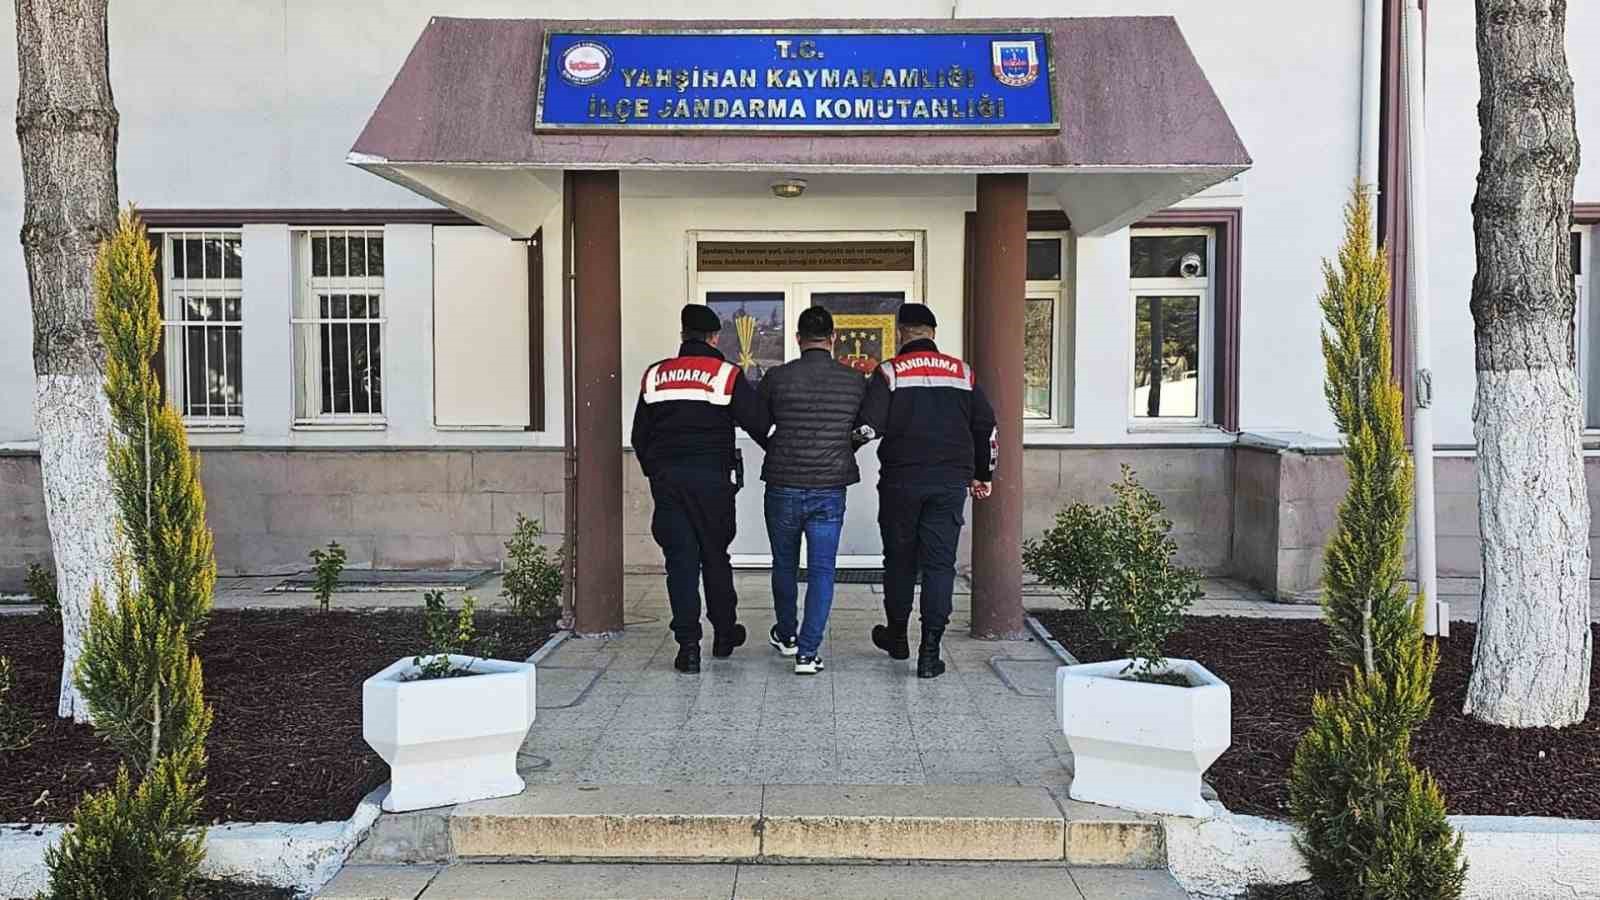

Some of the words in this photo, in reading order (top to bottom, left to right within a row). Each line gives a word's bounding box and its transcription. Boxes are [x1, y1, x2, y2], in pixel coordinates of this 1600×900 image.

[775, 40, 825, 59] T.C.
[621, 65, 757, 93] YAHŞİHAN
[766, 64, 976, 89] KAYMAKAMLIĞI
[588, 93, 650, 123] İLÇE
[657, 98, 807, 119] JANDARMA
[814, 93, 1006, 119] KOMUTANLIĞI
[895, 357, 958, 374] JANDARMA
